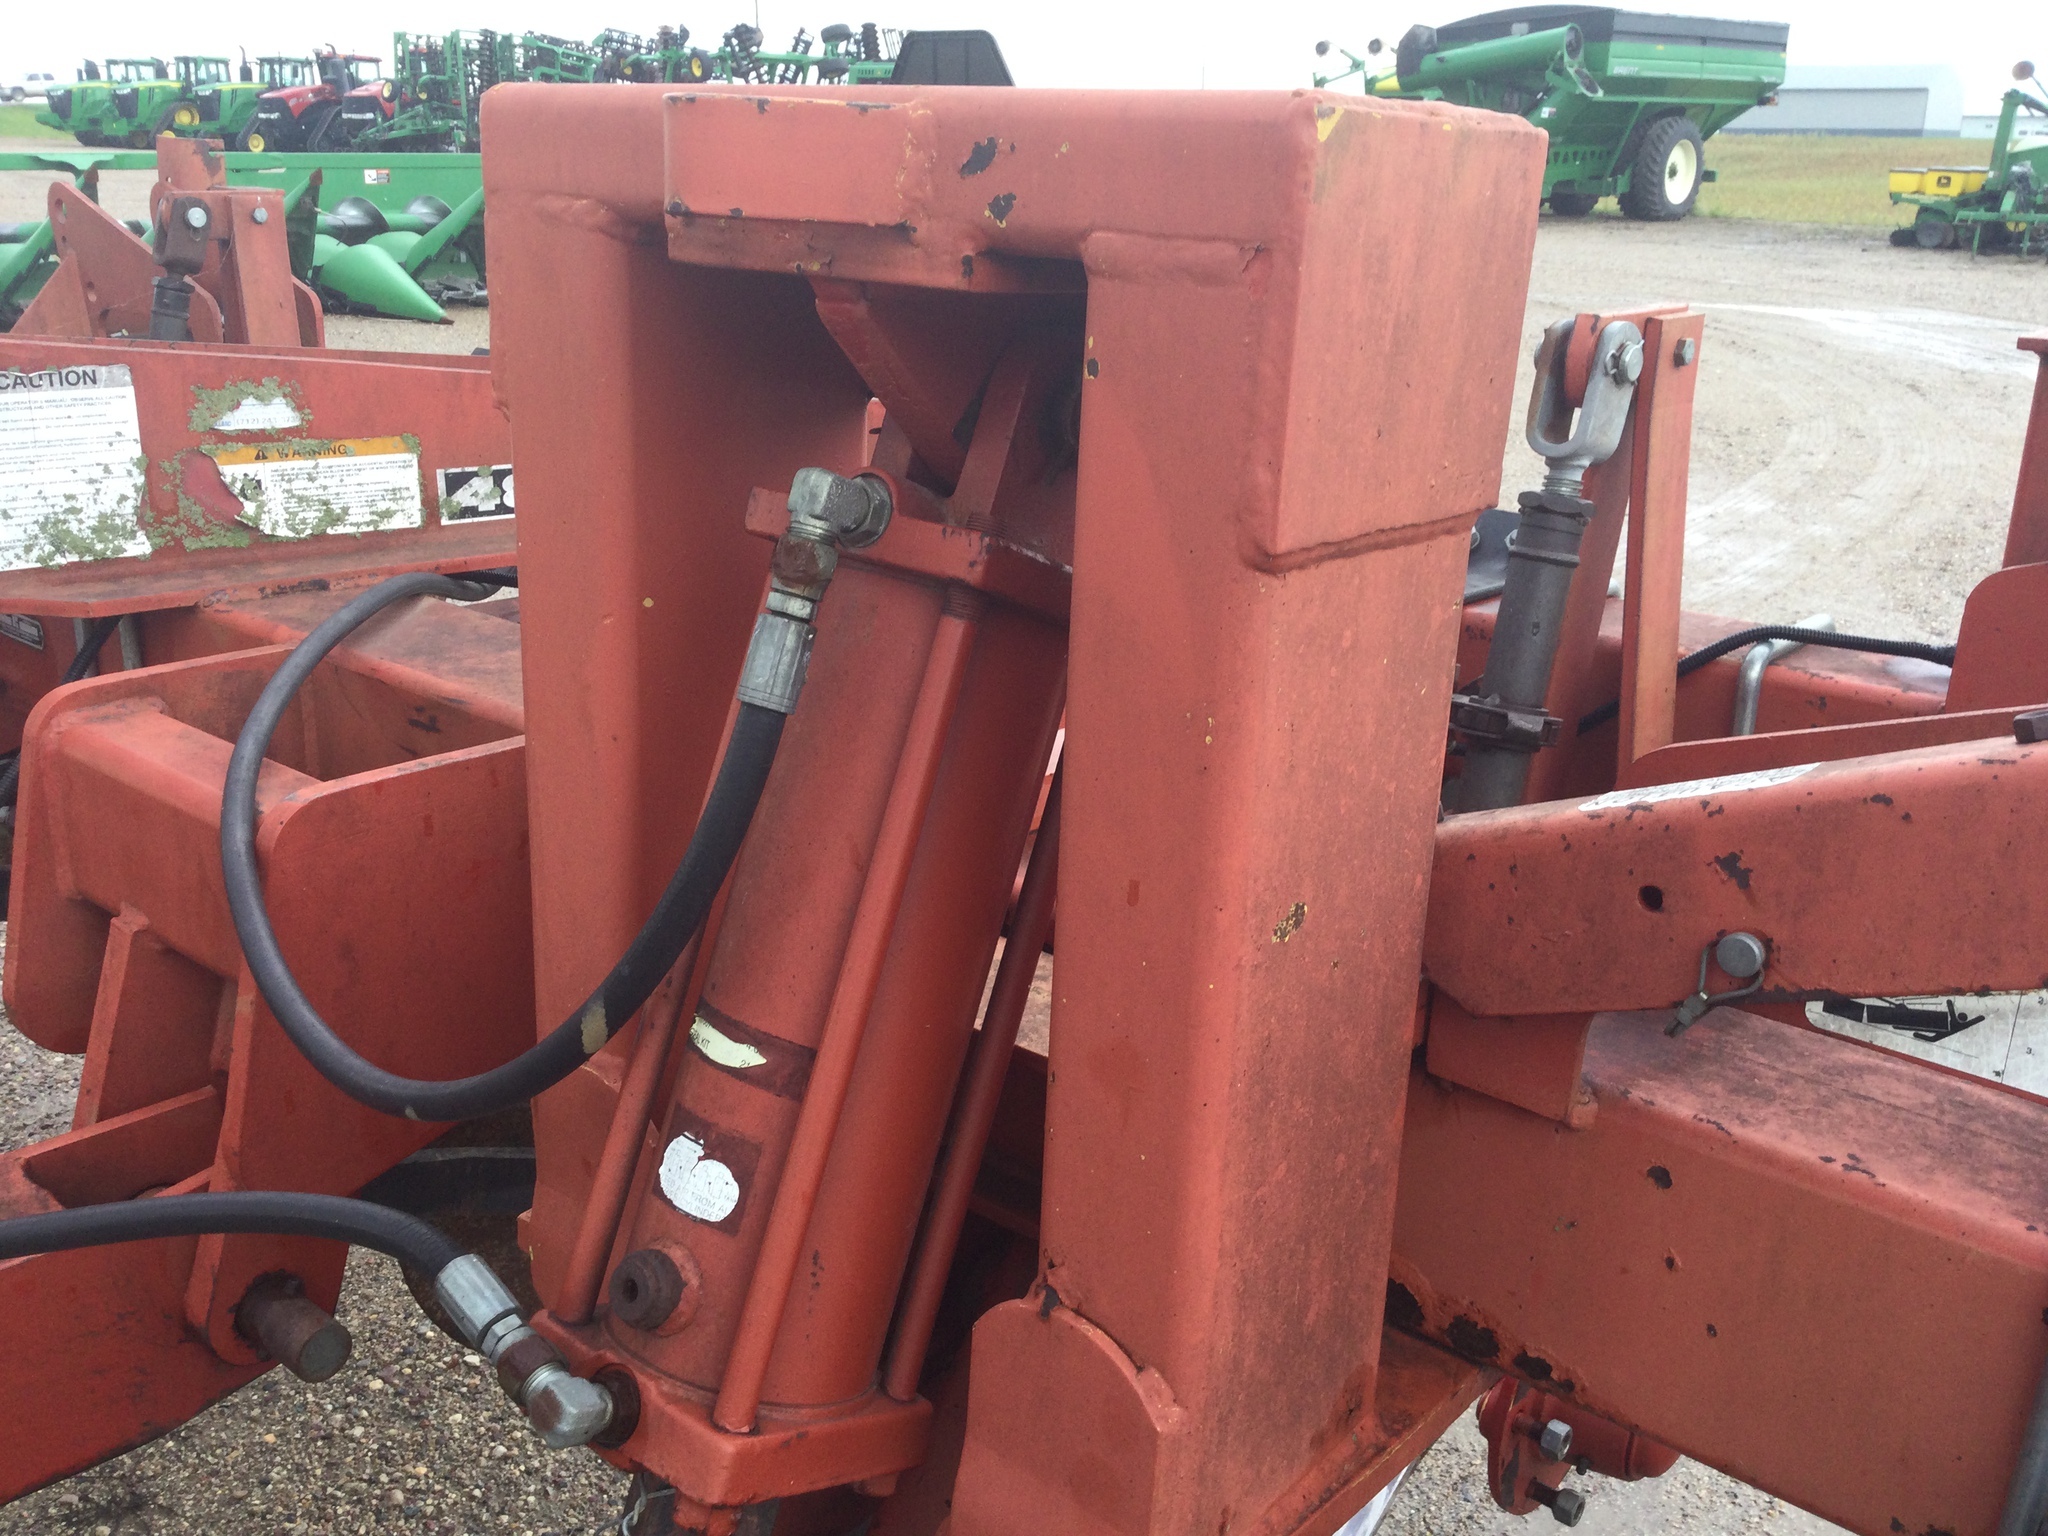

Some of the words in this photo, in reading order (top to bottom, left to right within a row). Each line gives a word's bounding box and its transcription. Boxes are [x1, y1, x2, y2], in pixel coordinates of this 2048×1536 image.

[0, 369, 97, 390] CAUTION
[2026, 1047, 2035, 1056] 3.
[691, 1191, 717, 1211] FROM
